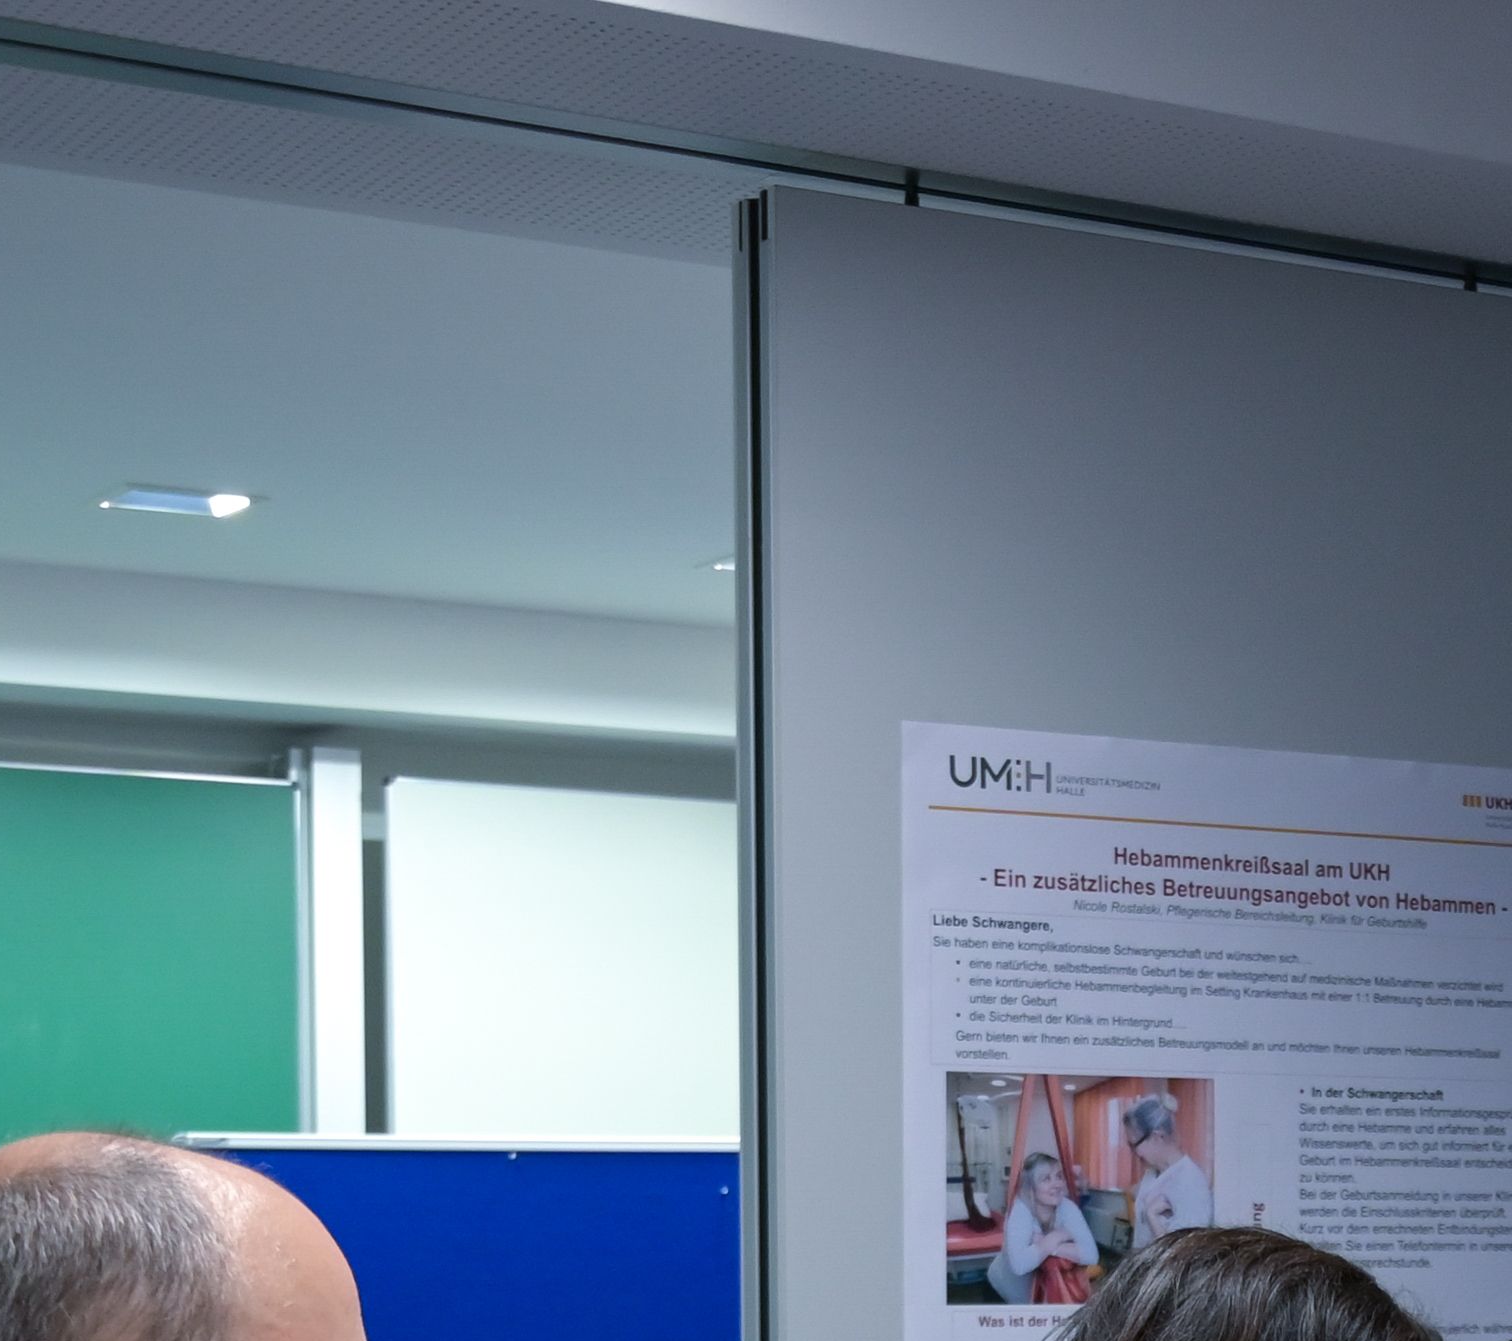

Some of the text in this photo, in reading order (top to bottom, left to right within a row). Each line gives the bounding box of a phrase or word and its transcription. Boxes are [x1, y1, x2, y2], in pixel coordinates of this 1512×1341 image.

[1485, 796, 1512, 810] UKH
[1114, 847, 1390, 881] Hebammenkreißsaal am UKH
[993, 868, 1495, 915] Ein zusätzliches Betreuungsangebot von Hebammen
[932, 914, 1052, 934] Liebe Schwangere,
[932, 935, 951, 947] Sie
[954, 937, 988, 949] haben
[991, 940, 1014, 950] eine
[1204, 949, 1223, 960] und
[1226, 951, 1276, 962] wünschen
[1178, 968, 1194, 978] bei
[1196, 969, 1213, 979] der
[1290, 972, 1307, 983] auf
[969, 994, 1057, 1007] unter der Geburt
[968, 1010, 985, 1021] die
[988, 1010, 1042, 1024] Sicherheit
[1045, 1014, 1062, 1024] der
[1065, 1014, 1093, 1024] Klinik
[1096, 1017, 1109, 1025] im
[955, 1048, 1008, 1060] vorstellen.
[1311, 1087, 1322, 1097] In
[1325, 1088, 1343, 1097] der
[978, 1315, 1049, 1328] Was ist der
